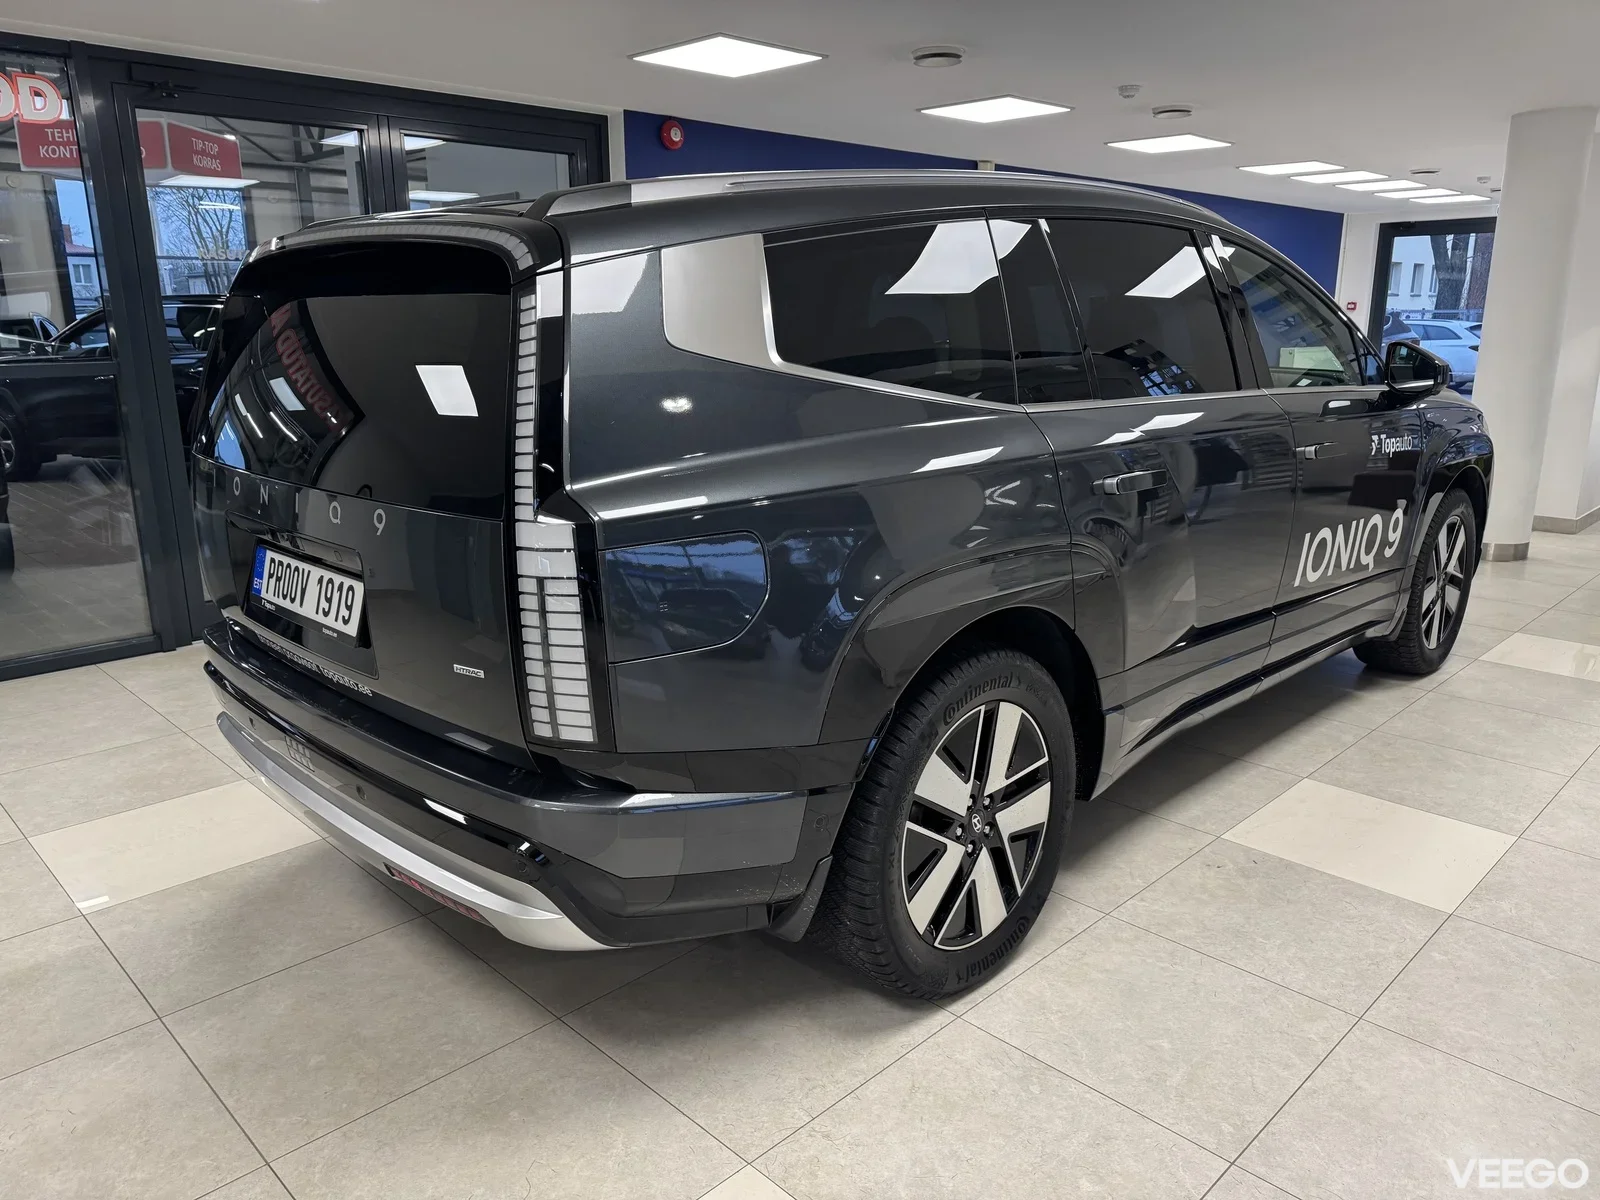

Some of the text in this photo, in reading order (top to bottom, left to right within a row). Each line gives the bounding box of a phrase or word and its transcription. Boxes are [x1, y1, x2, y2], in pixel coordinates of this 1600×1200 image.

[45, 129, 77, 141] TEH
[191, 137, 219, 155] TIP-TOP
[192, 153, 222, 171] KORRAS
[1380, 434, 1413, 458] Topauto
[213, 468, 386, 536] IONIQ 9
[1294, 508, 1404, 588] IONIQ 9
[253, 577, 263, 589] EST
[316, 574, 355, 626] 1919
[455, 665, 482, 677] HTRAC
[943, 671, 1013, 727] Continental
[965, 915, 1031, 984] Continental
